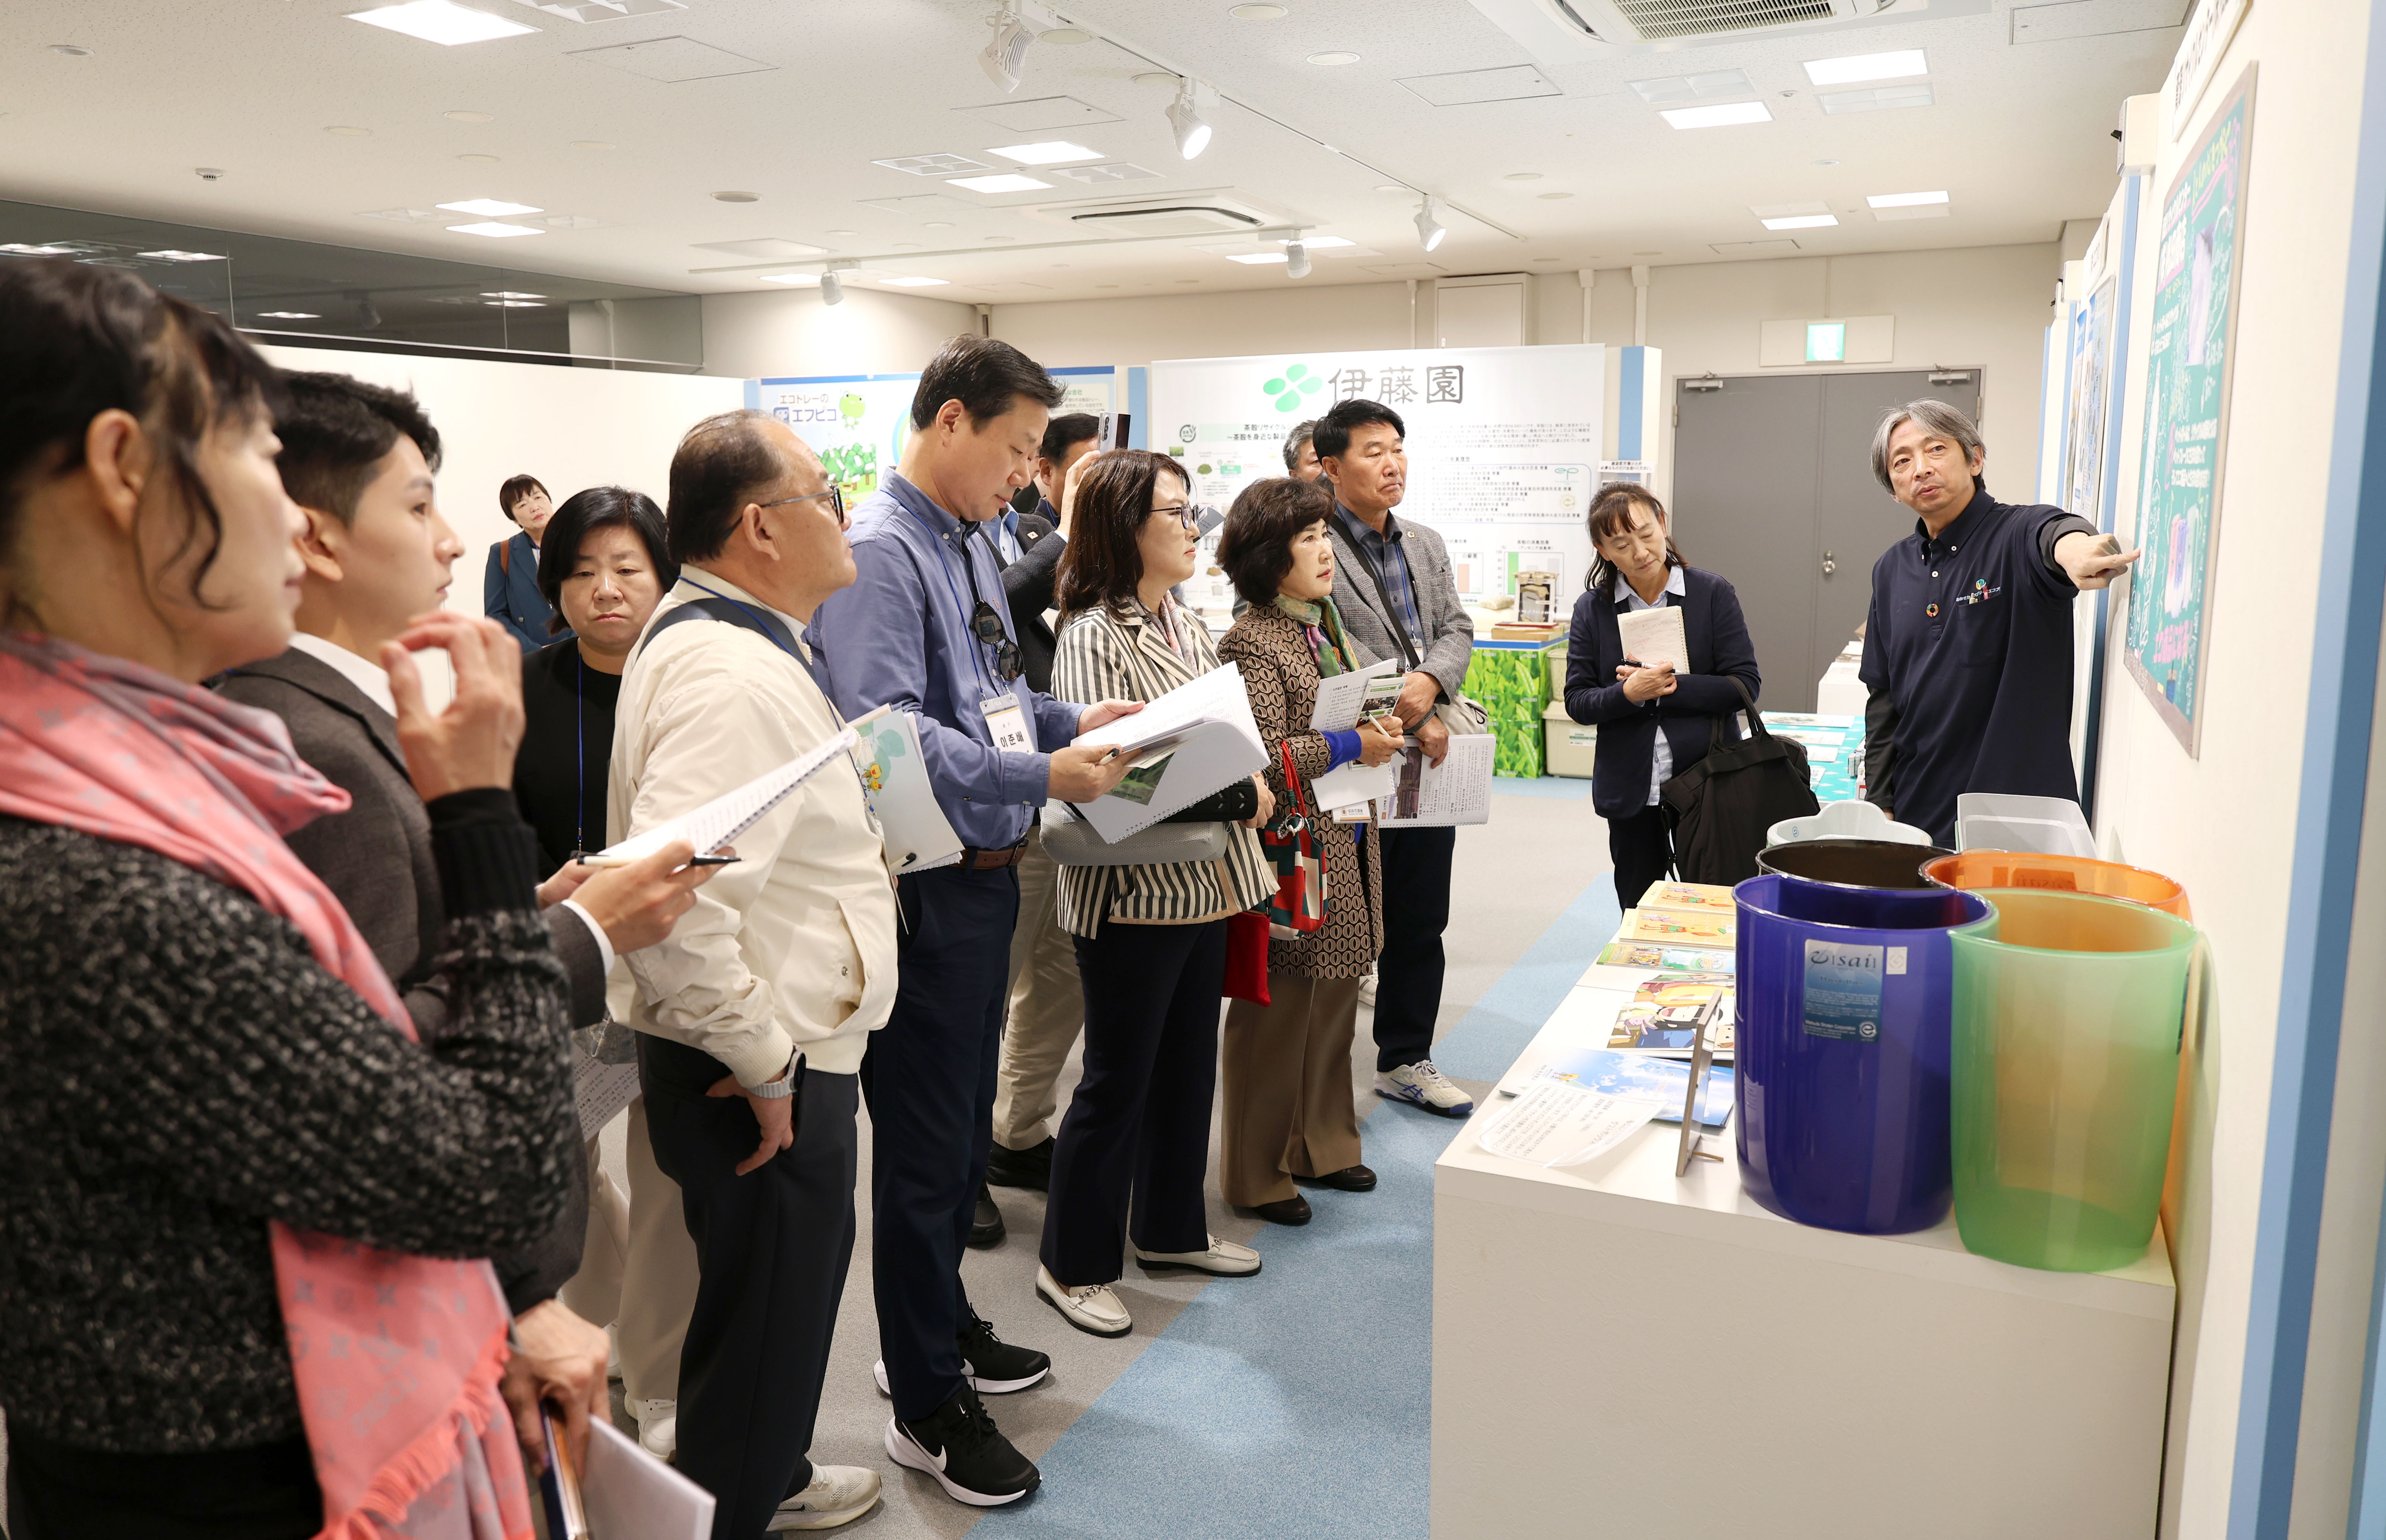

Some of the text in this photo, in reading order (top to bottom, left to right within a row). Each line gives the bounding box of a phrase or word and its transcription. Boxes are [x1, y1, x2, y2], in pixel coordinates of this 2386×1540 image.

[1327, 365, 1464, 405] 伊藤園
[780, 393, 829, 404] エコトレーの
[792, 406, 837, 422] エフピコ
[1000, 731, 1024, 747] 이준배
